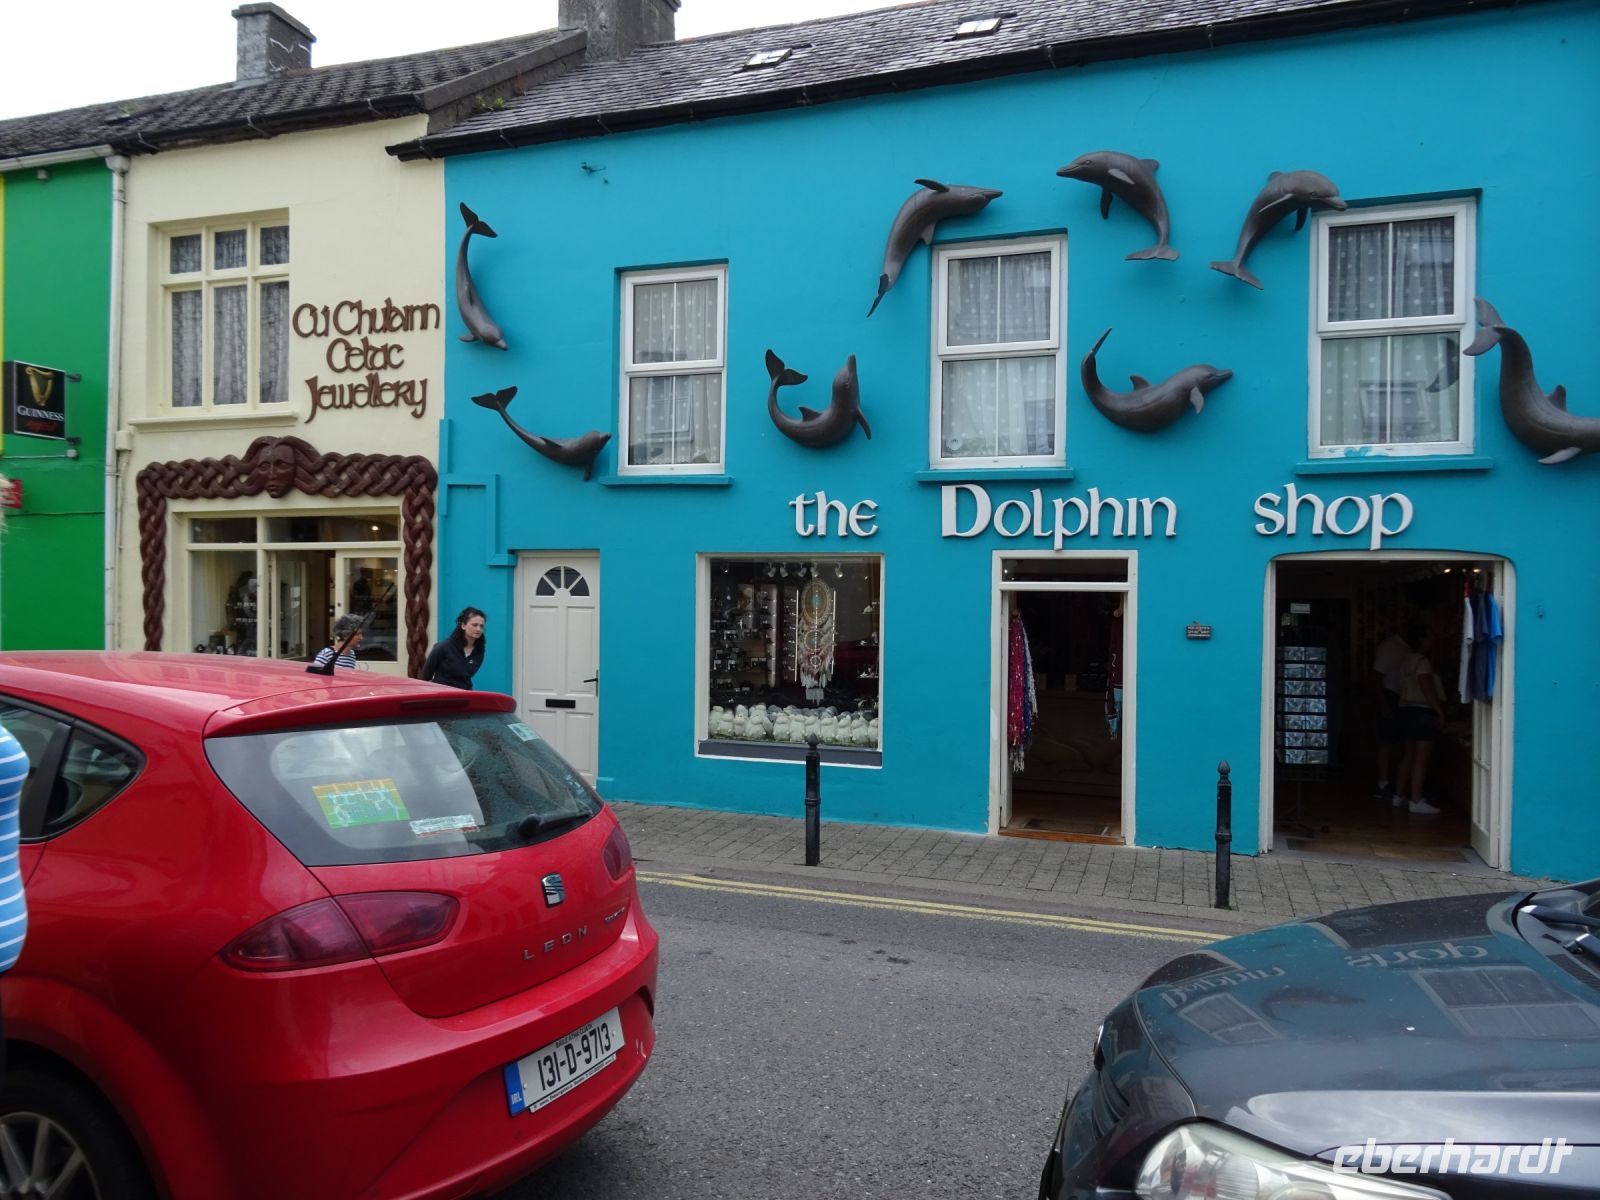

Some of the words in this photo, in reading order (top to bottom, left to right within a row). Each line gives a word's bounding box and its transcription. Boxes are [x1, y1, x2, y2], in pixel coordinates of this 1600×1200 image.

[326, 337, 404, 373] Celtic
[17, 405, 64, 421] GUINNESS
[304, 372, 428, 424] Jewellery
[788, 490, 879, 537] the
[941, 483, 1177, 551] Dolphin
[1254, 482, 1413, 551] shop
[523, 925, 587, 960] LEON
[537, 1022, 611, 1091] 131-D-9713
[511, 1092, 523, 1105] IRL
